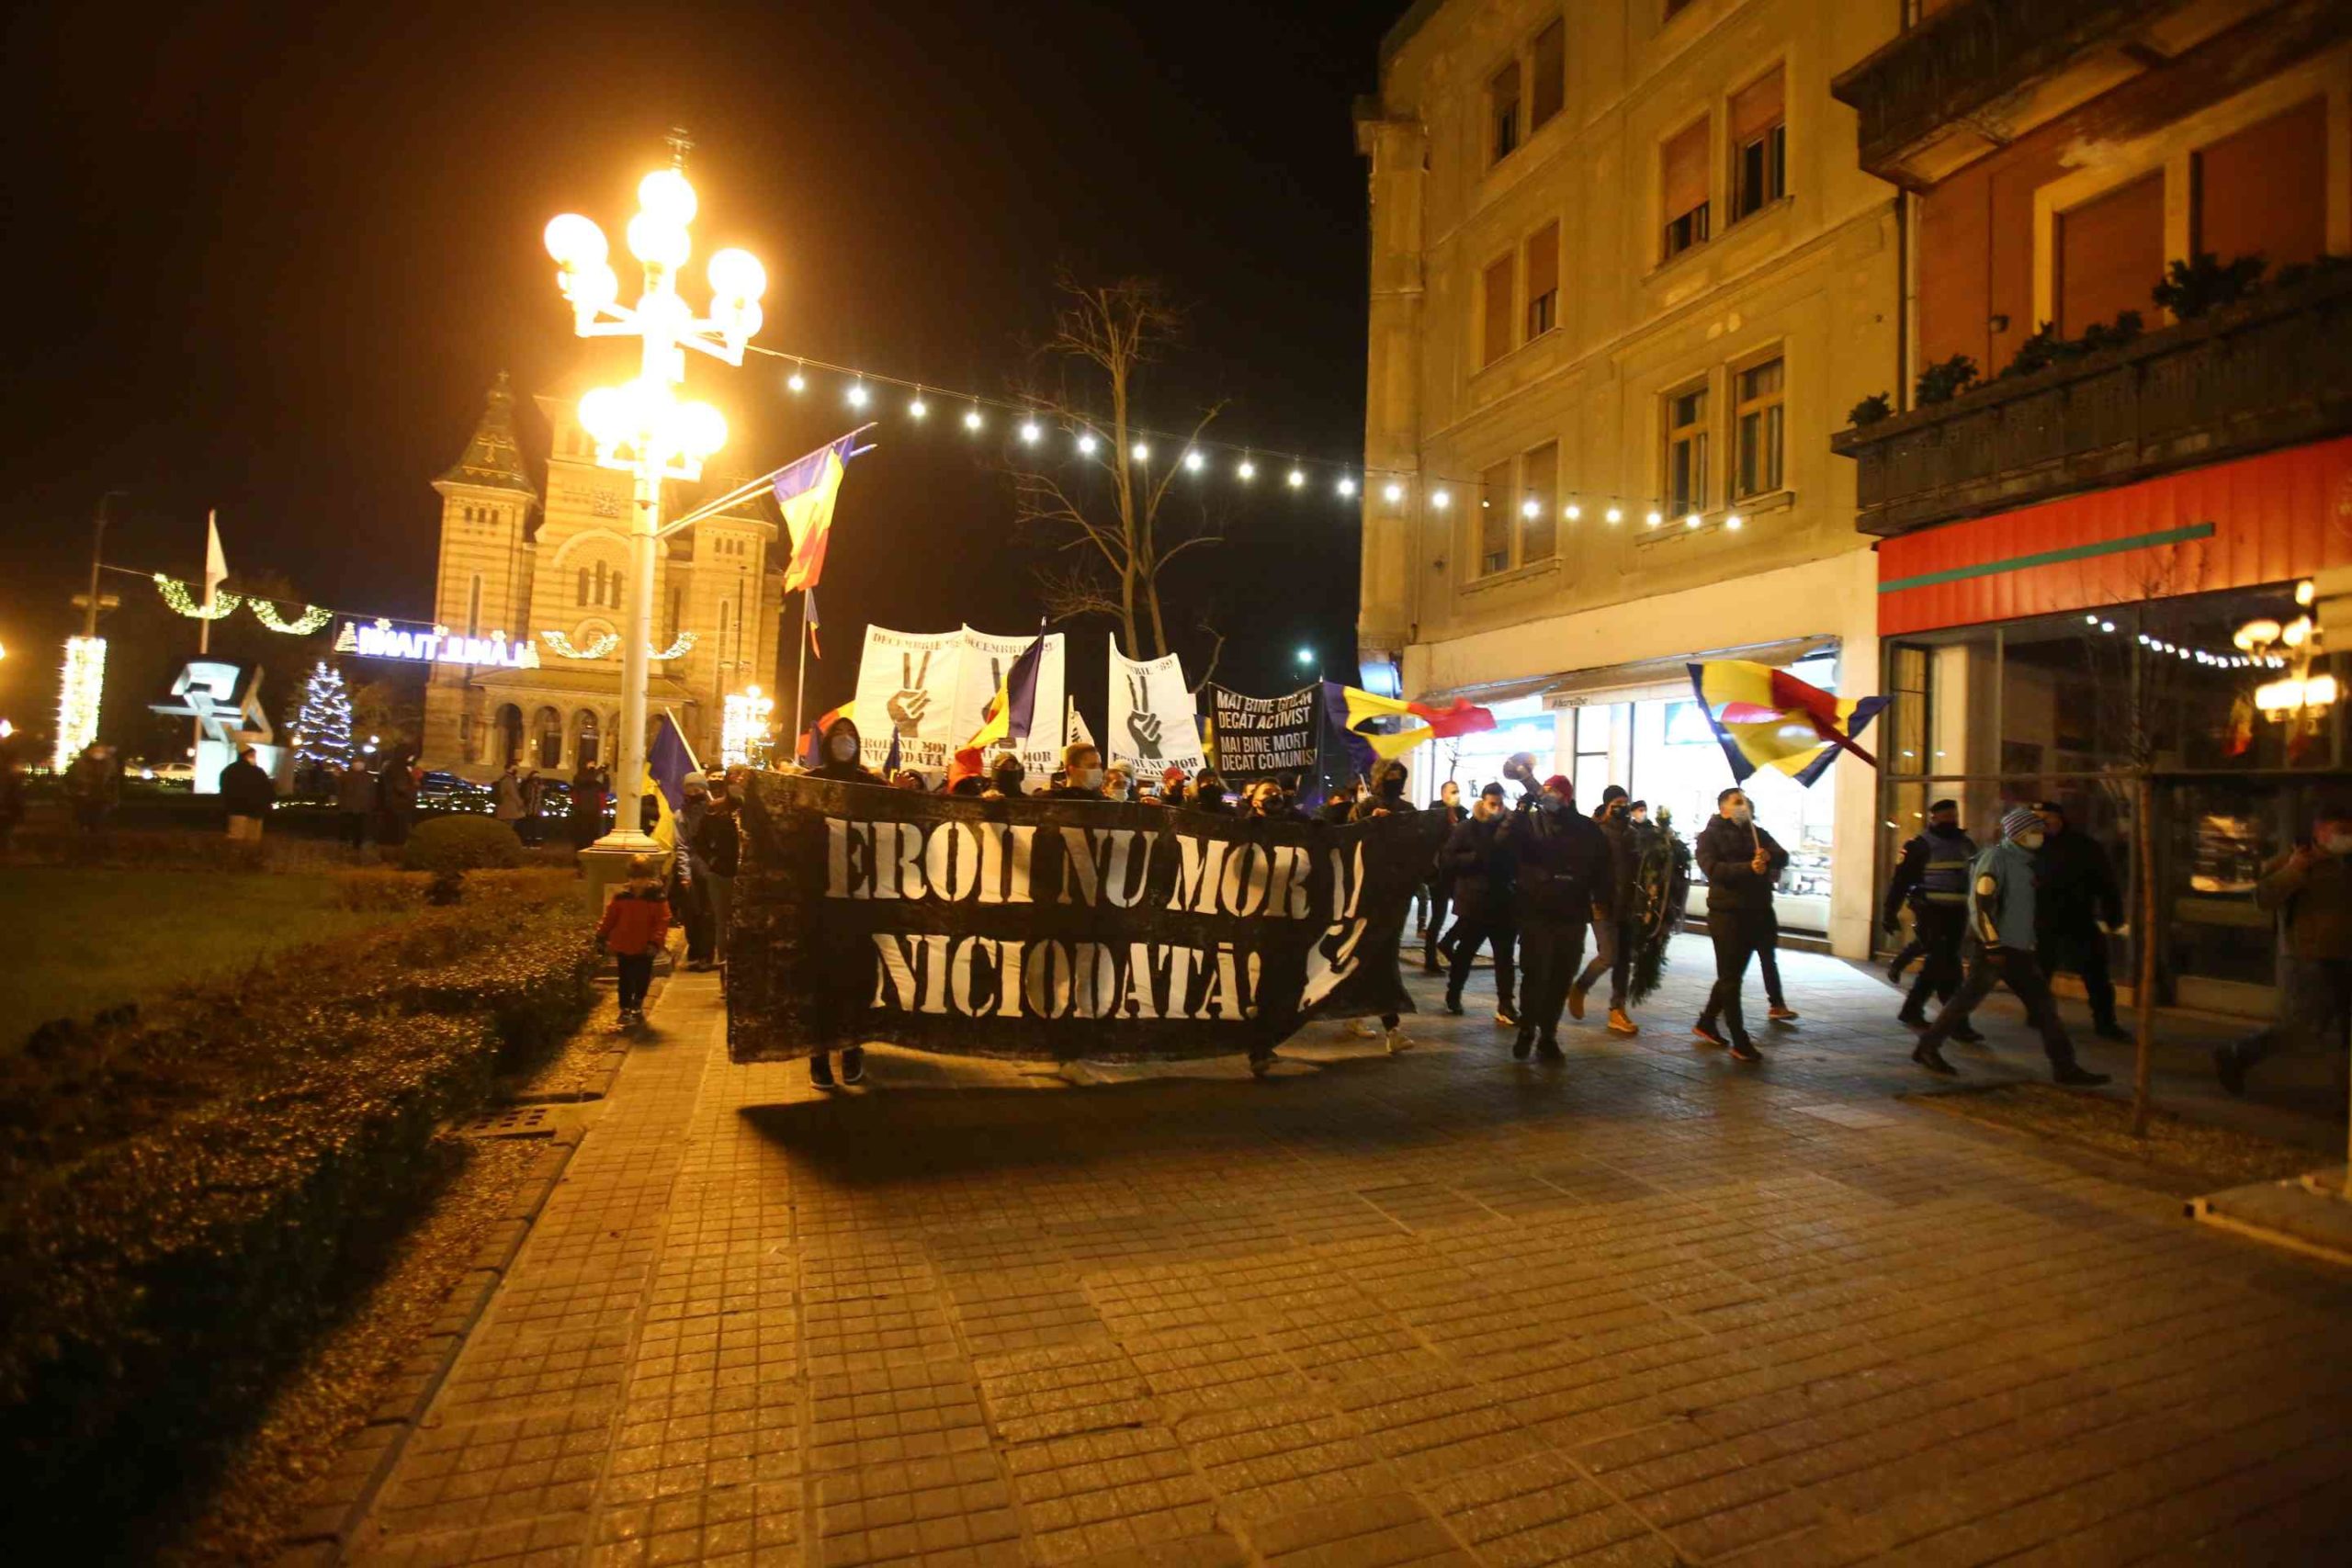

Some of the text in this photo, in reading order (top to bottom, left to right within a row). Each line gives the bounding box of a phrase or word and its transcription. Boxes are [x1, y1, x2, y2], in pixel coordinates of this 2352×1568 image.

[1216, 690, 1243, 710] MAI
[1244, 696, 1275, 714] BINE
[1256, 706, 1311, 729] ACTIVIST
[1220, 731, 1309, 753] MAI BINE MORT
[824, 817, 1312, 919] EROII NU MOR
